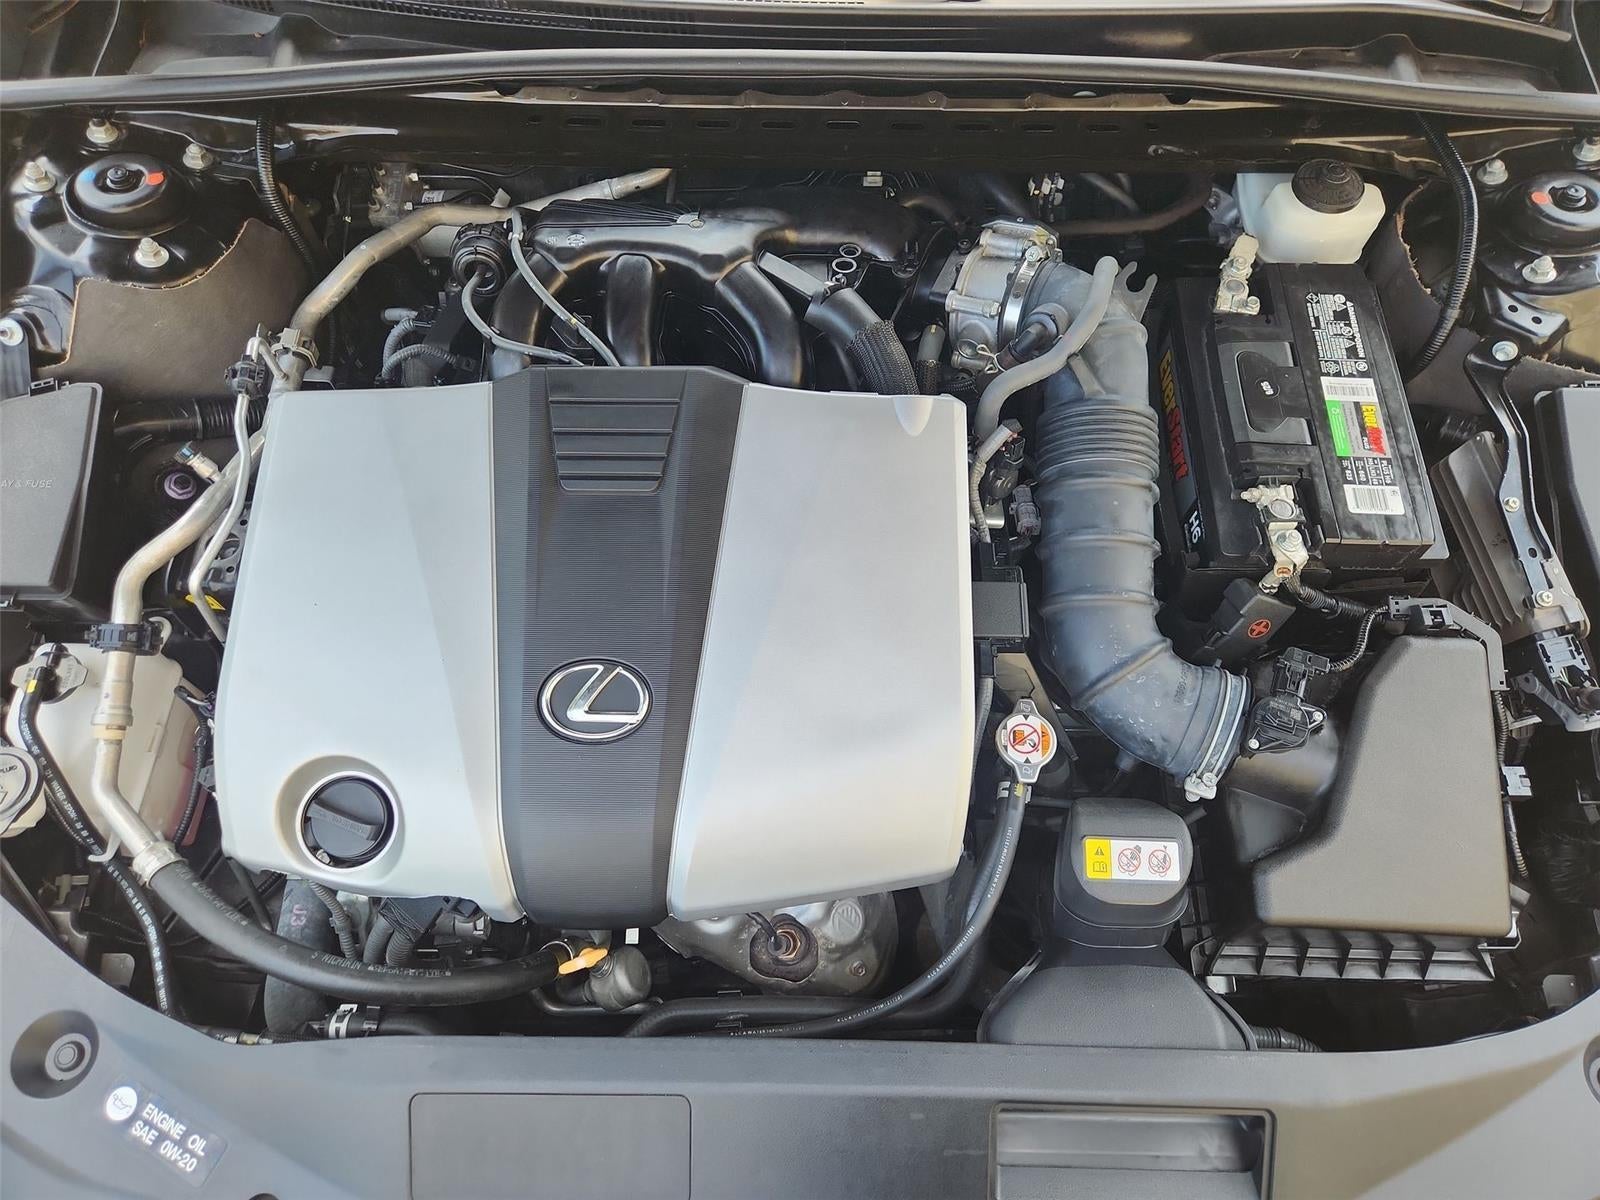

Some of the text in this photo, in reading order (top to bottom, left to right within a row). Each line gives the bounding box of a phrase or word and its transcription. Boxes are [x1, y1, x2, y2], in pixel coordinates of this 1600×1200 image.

[1160, 351, 1188, 480] EverStart
[25, 479, 53, 489] FUSE
[1381, 461, 1389, 474] PLUS
[1187, 510, 1201, 546] H6
[130, 1120, 199, 1173] SAE 0W-20
[141, 1102, 207, 1157] ENGINE OIL
